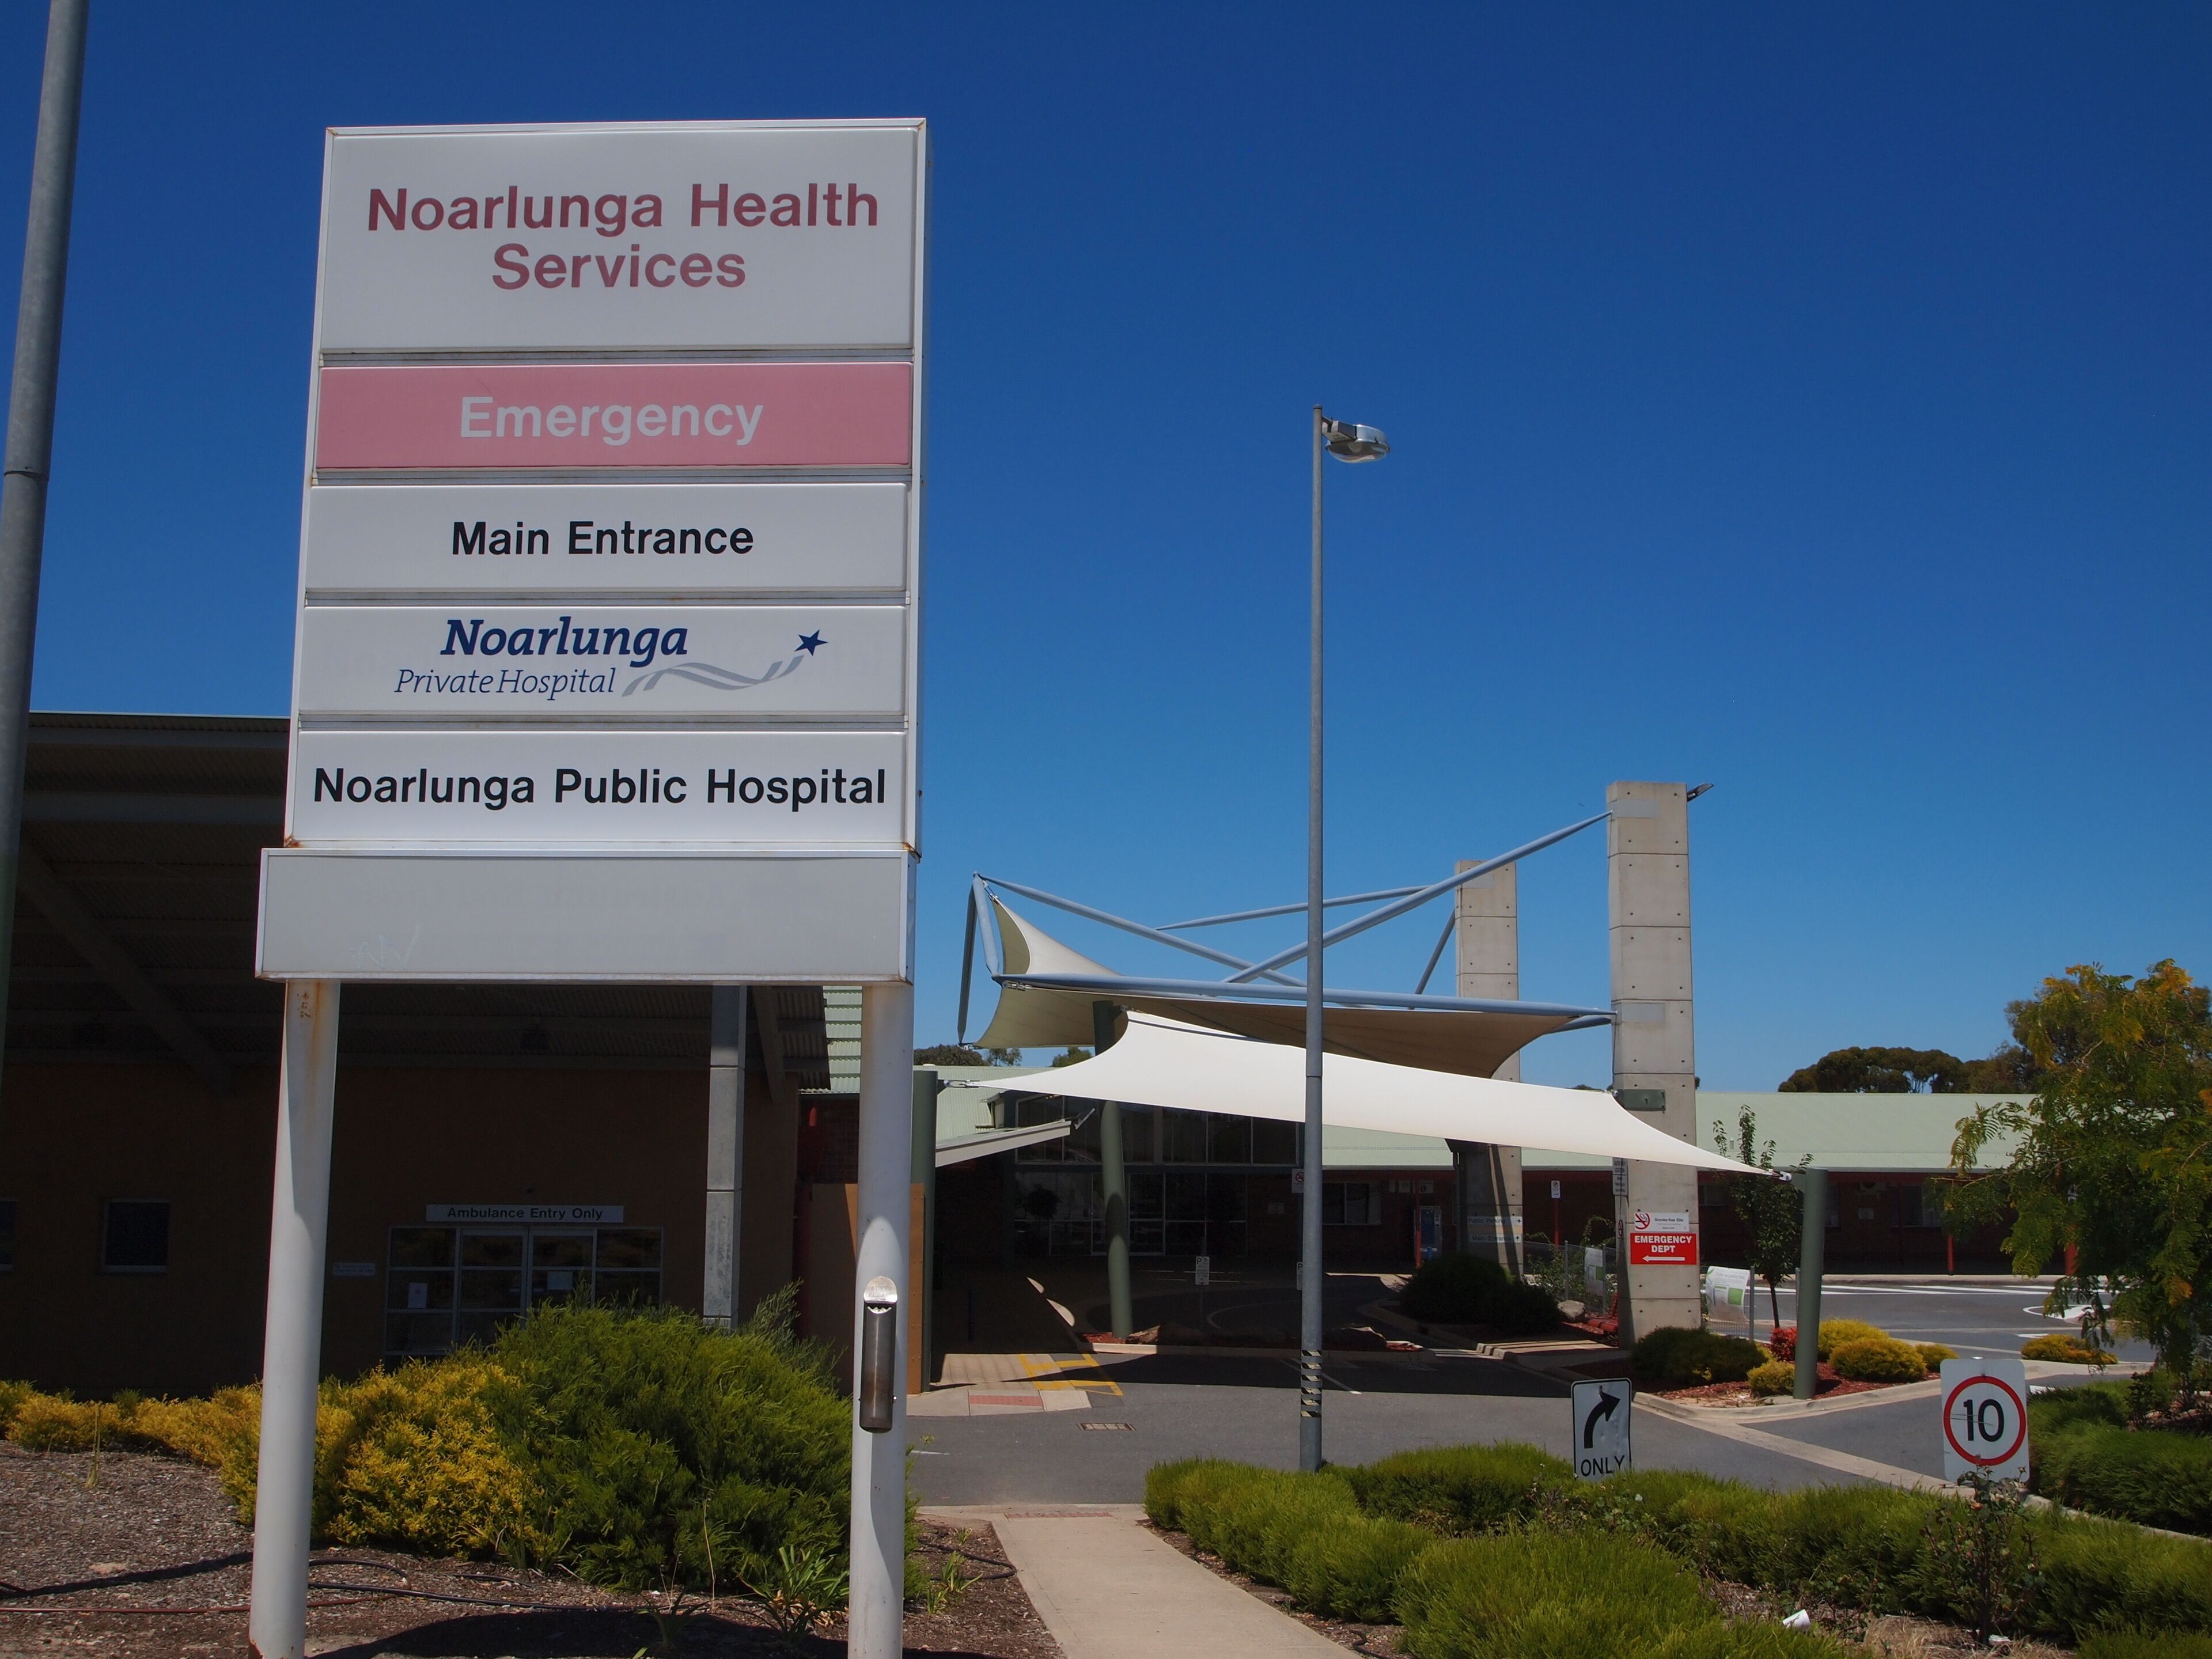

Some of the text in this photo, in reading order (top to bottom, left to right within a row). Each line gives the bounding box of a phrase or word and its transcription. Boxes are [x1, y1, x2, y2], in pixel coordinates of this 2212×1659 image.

[368, 183, 878, 237] Noarlunga Health
[492, 244, 745, 290] Services
[460, 396, 764, 446] Emergency
[452, 521, 753, 555] Main Entrance
[440, 616, 688, 668] Noarlunga
[314, 768, 885, 812] Noarlunga Public Hospital
[447, 1207, 603, 1221] Ambulance Entry Only
[1634, 1236, 1692, 1244] EMERGENCY
[1651, 1245, 1676, 1253] DEPT
[1963, 1399, 2005, 1442] 10
[1581, 1455, 1625, 1476] ONLY
